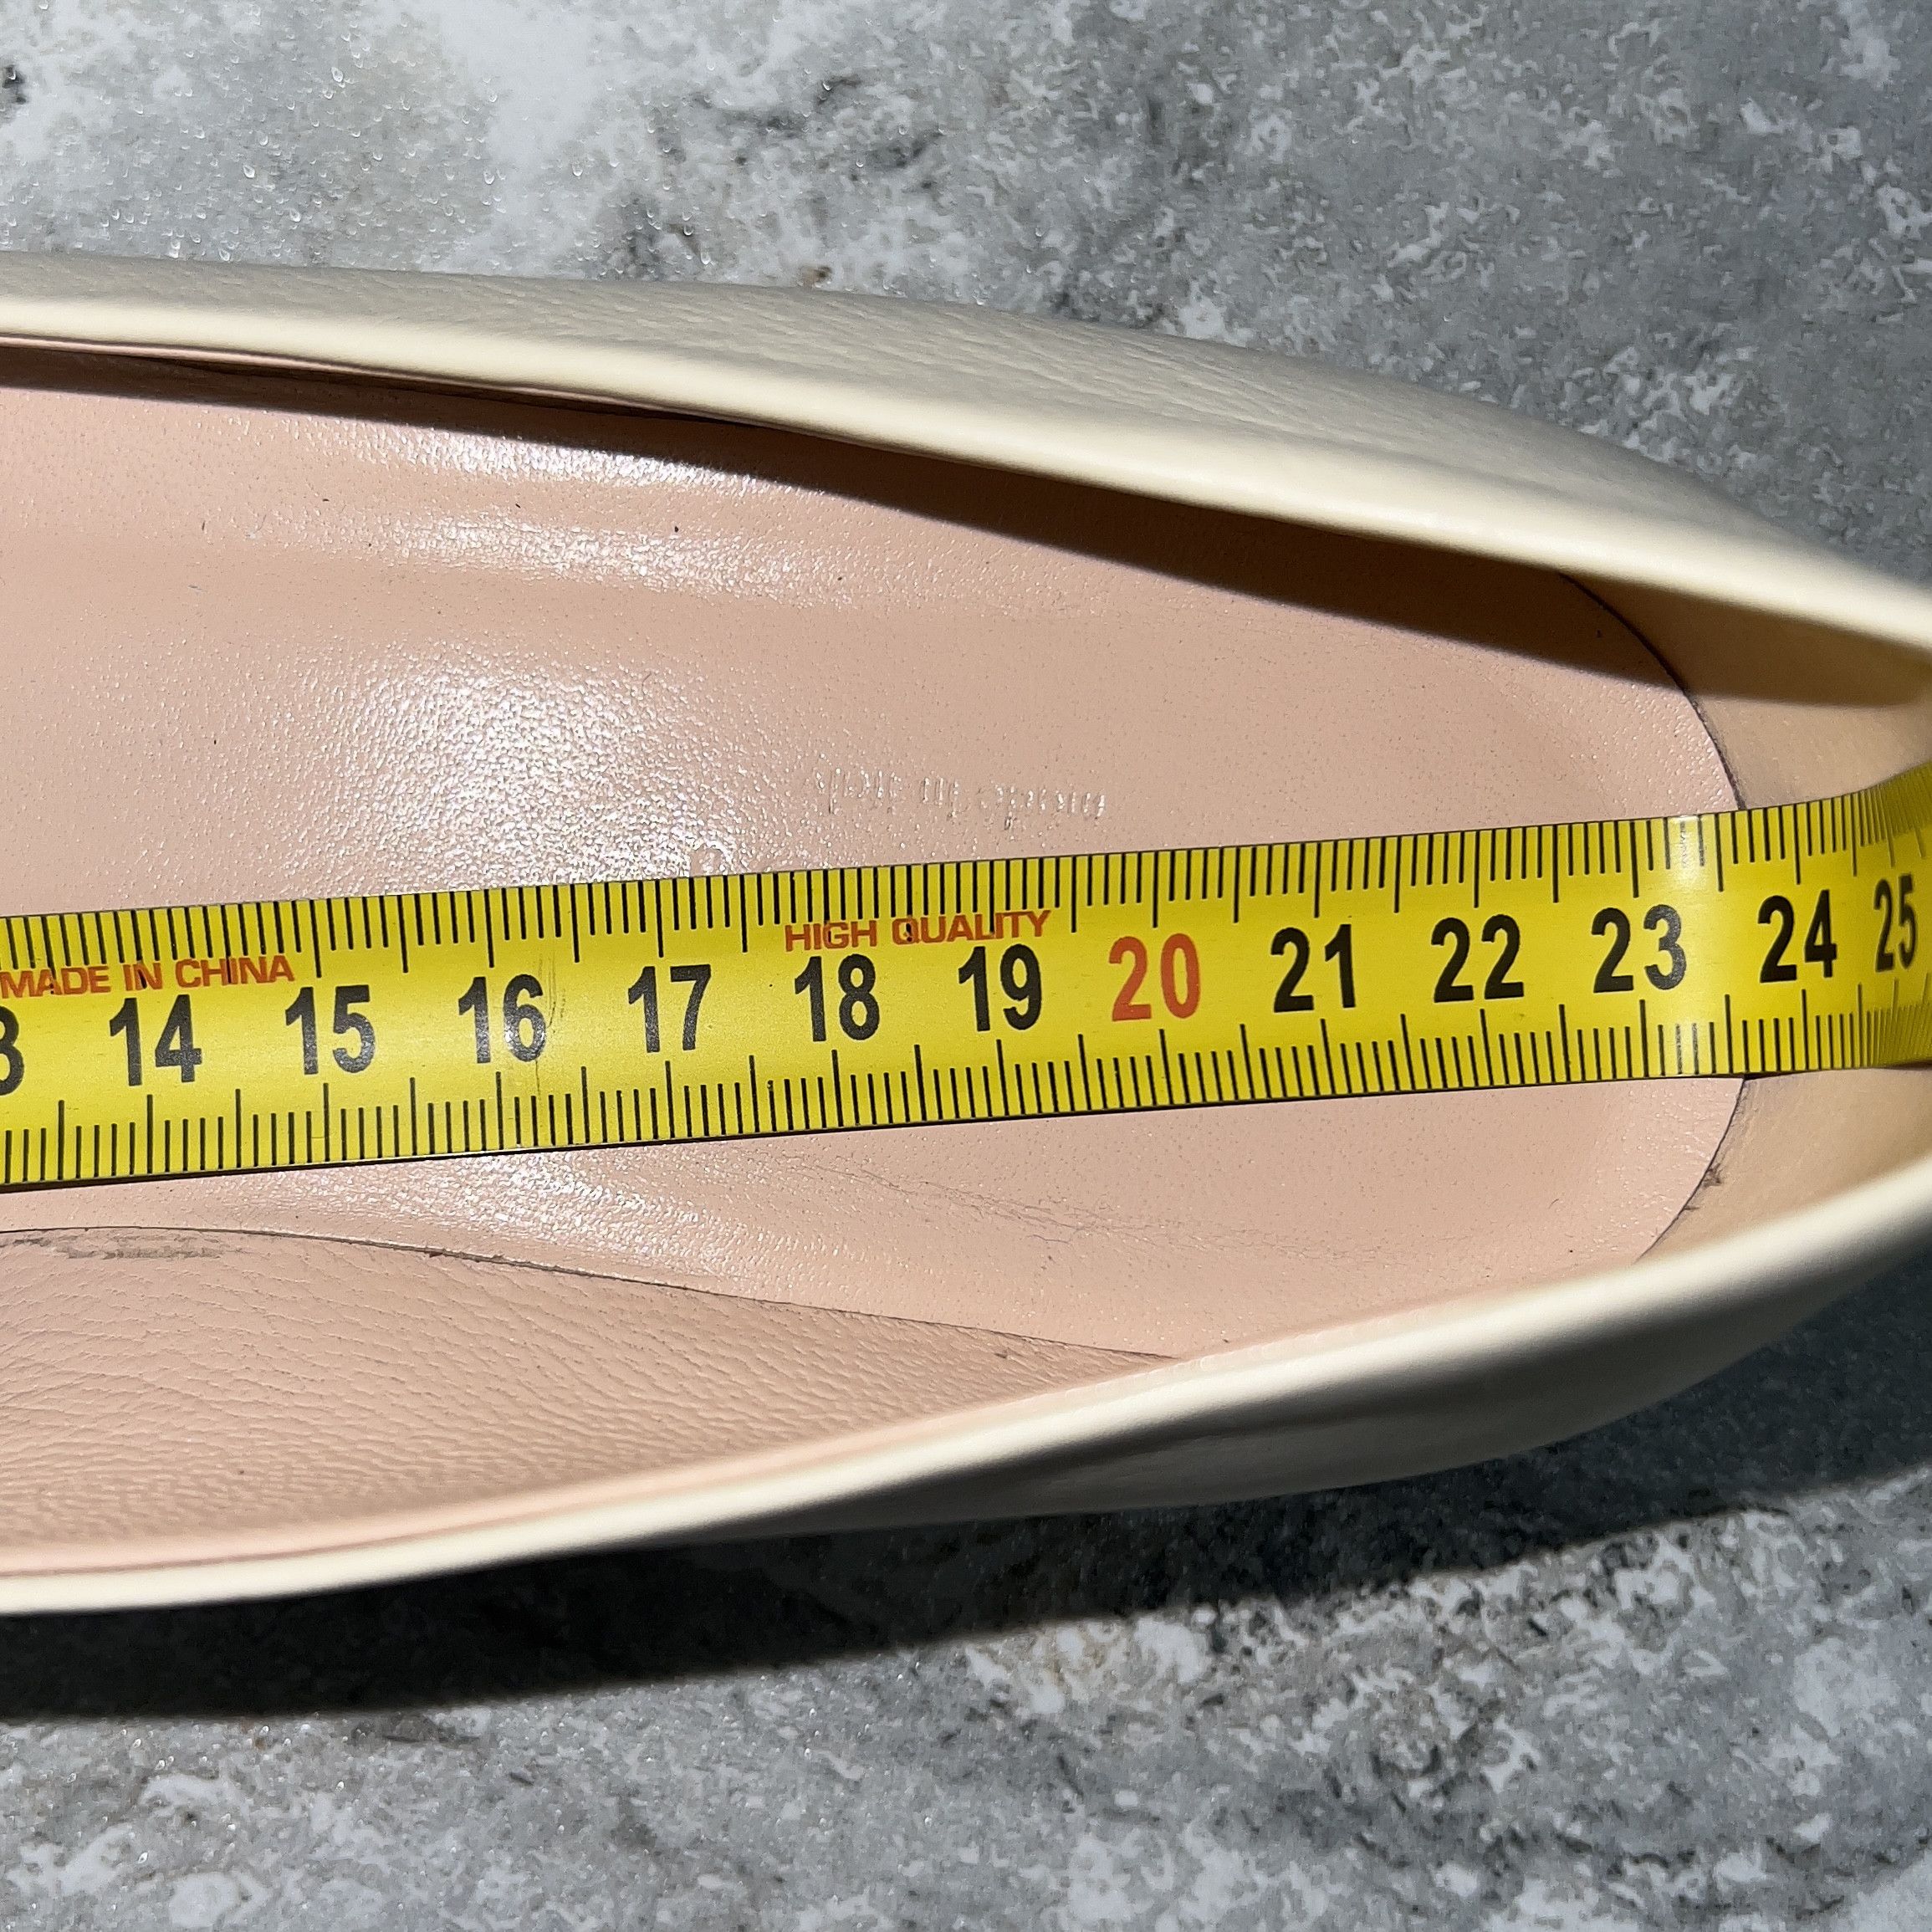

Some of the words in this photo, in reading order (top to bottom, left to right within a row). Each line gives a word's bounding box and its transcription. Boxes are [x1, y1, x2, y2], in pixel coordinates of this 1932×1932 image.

[784, 919, 879, 952] HIGH
[891, 909, 1050, 946] QUALITY
[0, 965, 112, 999] MADE
[122, 961, 165, 992] IN
[175, 954, 295, 989] CHINA
[109, 994, 202, 1086] 14
[284, 984, 376, 1076] 15
[457, 974, 548, 1064] 16
[627, 963, 713, 1054] 17
[794, 953, 881, 1043] 18
[958, 943, 1043, 1032] 19
[1108, 933, 1201, 1022] 20
[1270, 923, 1357, 1014] 21
[1430, 913, 1526, 1004] 22
[1591, 904, 1688, 994] 23
[1757, 889, 1838, 984] 24
[1873, 872, 1919, 973] 25
